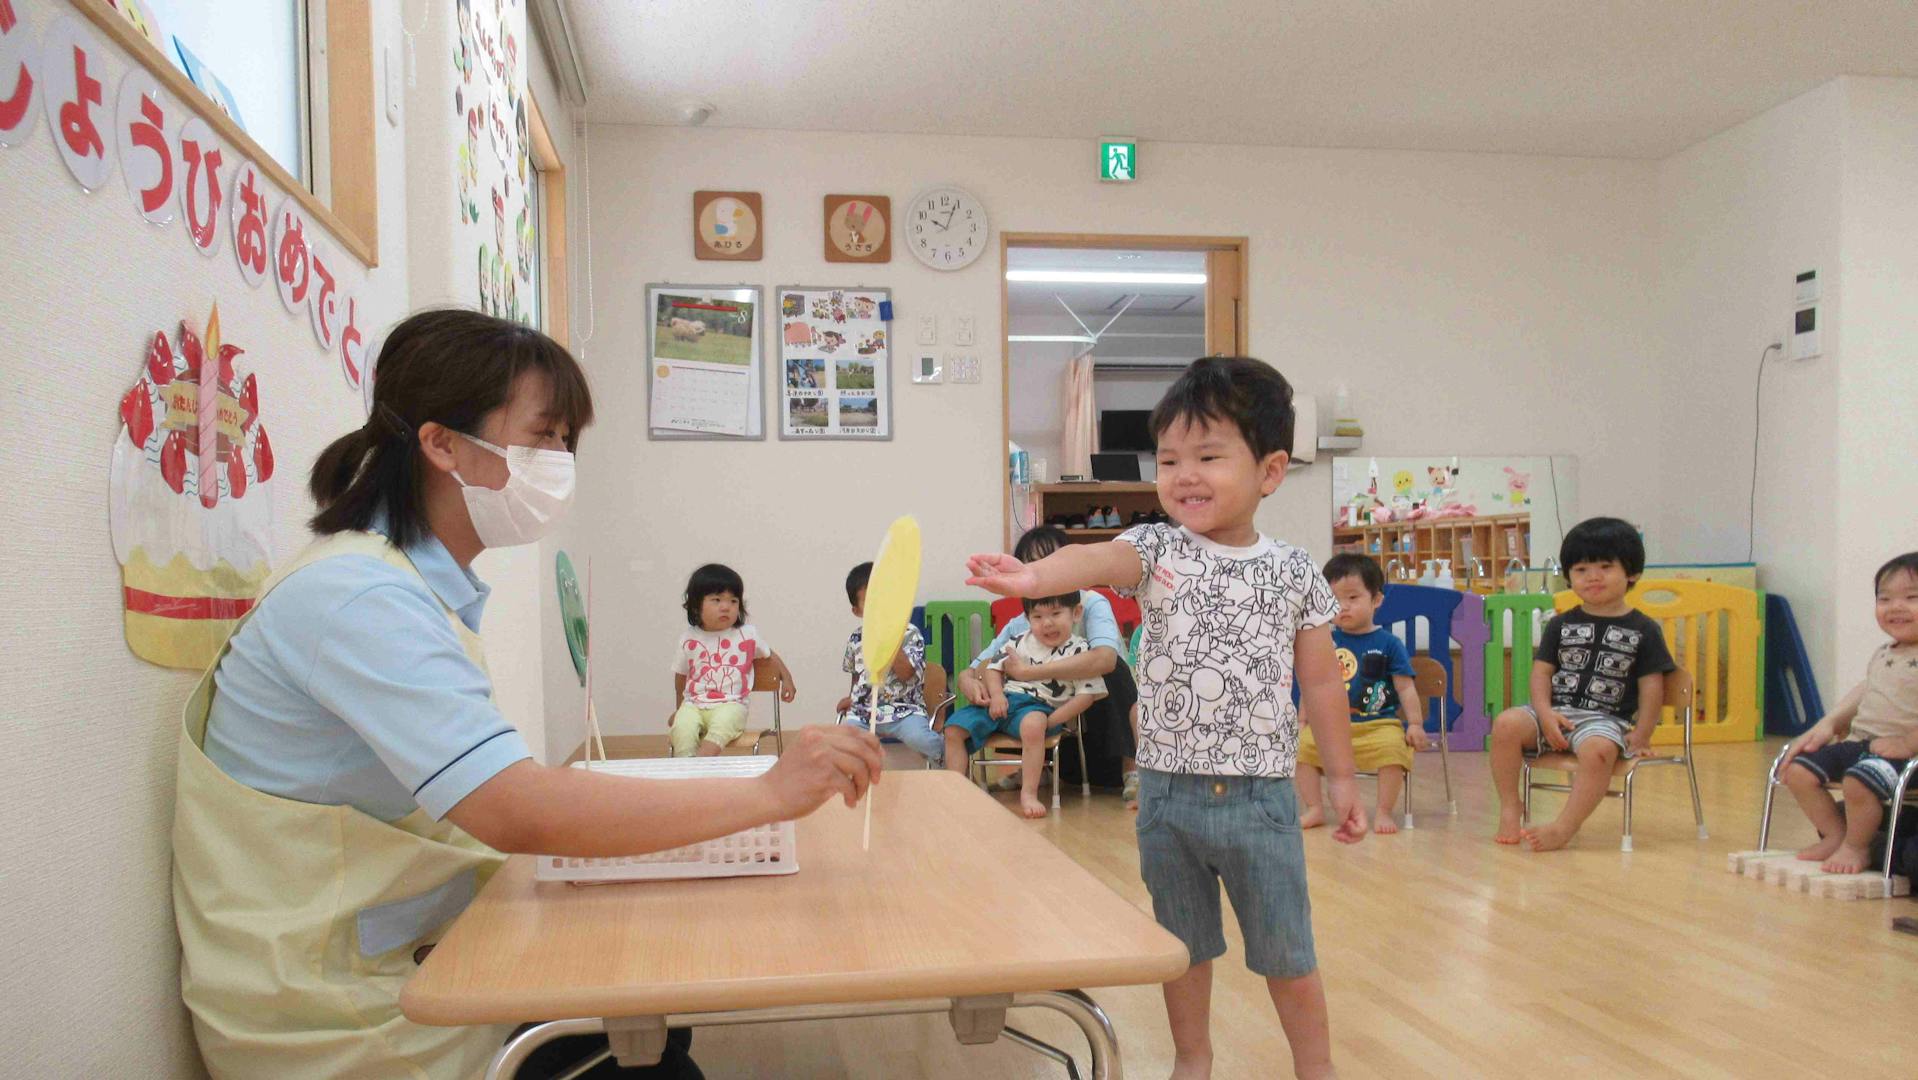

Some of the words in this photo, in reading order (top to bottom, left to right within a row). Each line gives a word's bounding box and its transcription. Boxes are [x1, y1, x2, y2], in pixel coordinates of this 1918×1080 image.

[928, 200, 935, 210] 11
[940, 195, 950, 207] 12
[919, 210, 928, 220] 10
[966, 208, 973, 219] 2
[916, 223, 923, 234] 9
[970, 223, 977, 233] 3
[714, 240, 743, 249] あひる
[845, 242, 873, 252] うさぎ
[920, 238, 927, 248] 8
[930, 248, 937, 259] 7
[944, 251, 952, 263] 6
[958, 247, 965, 258] 5
